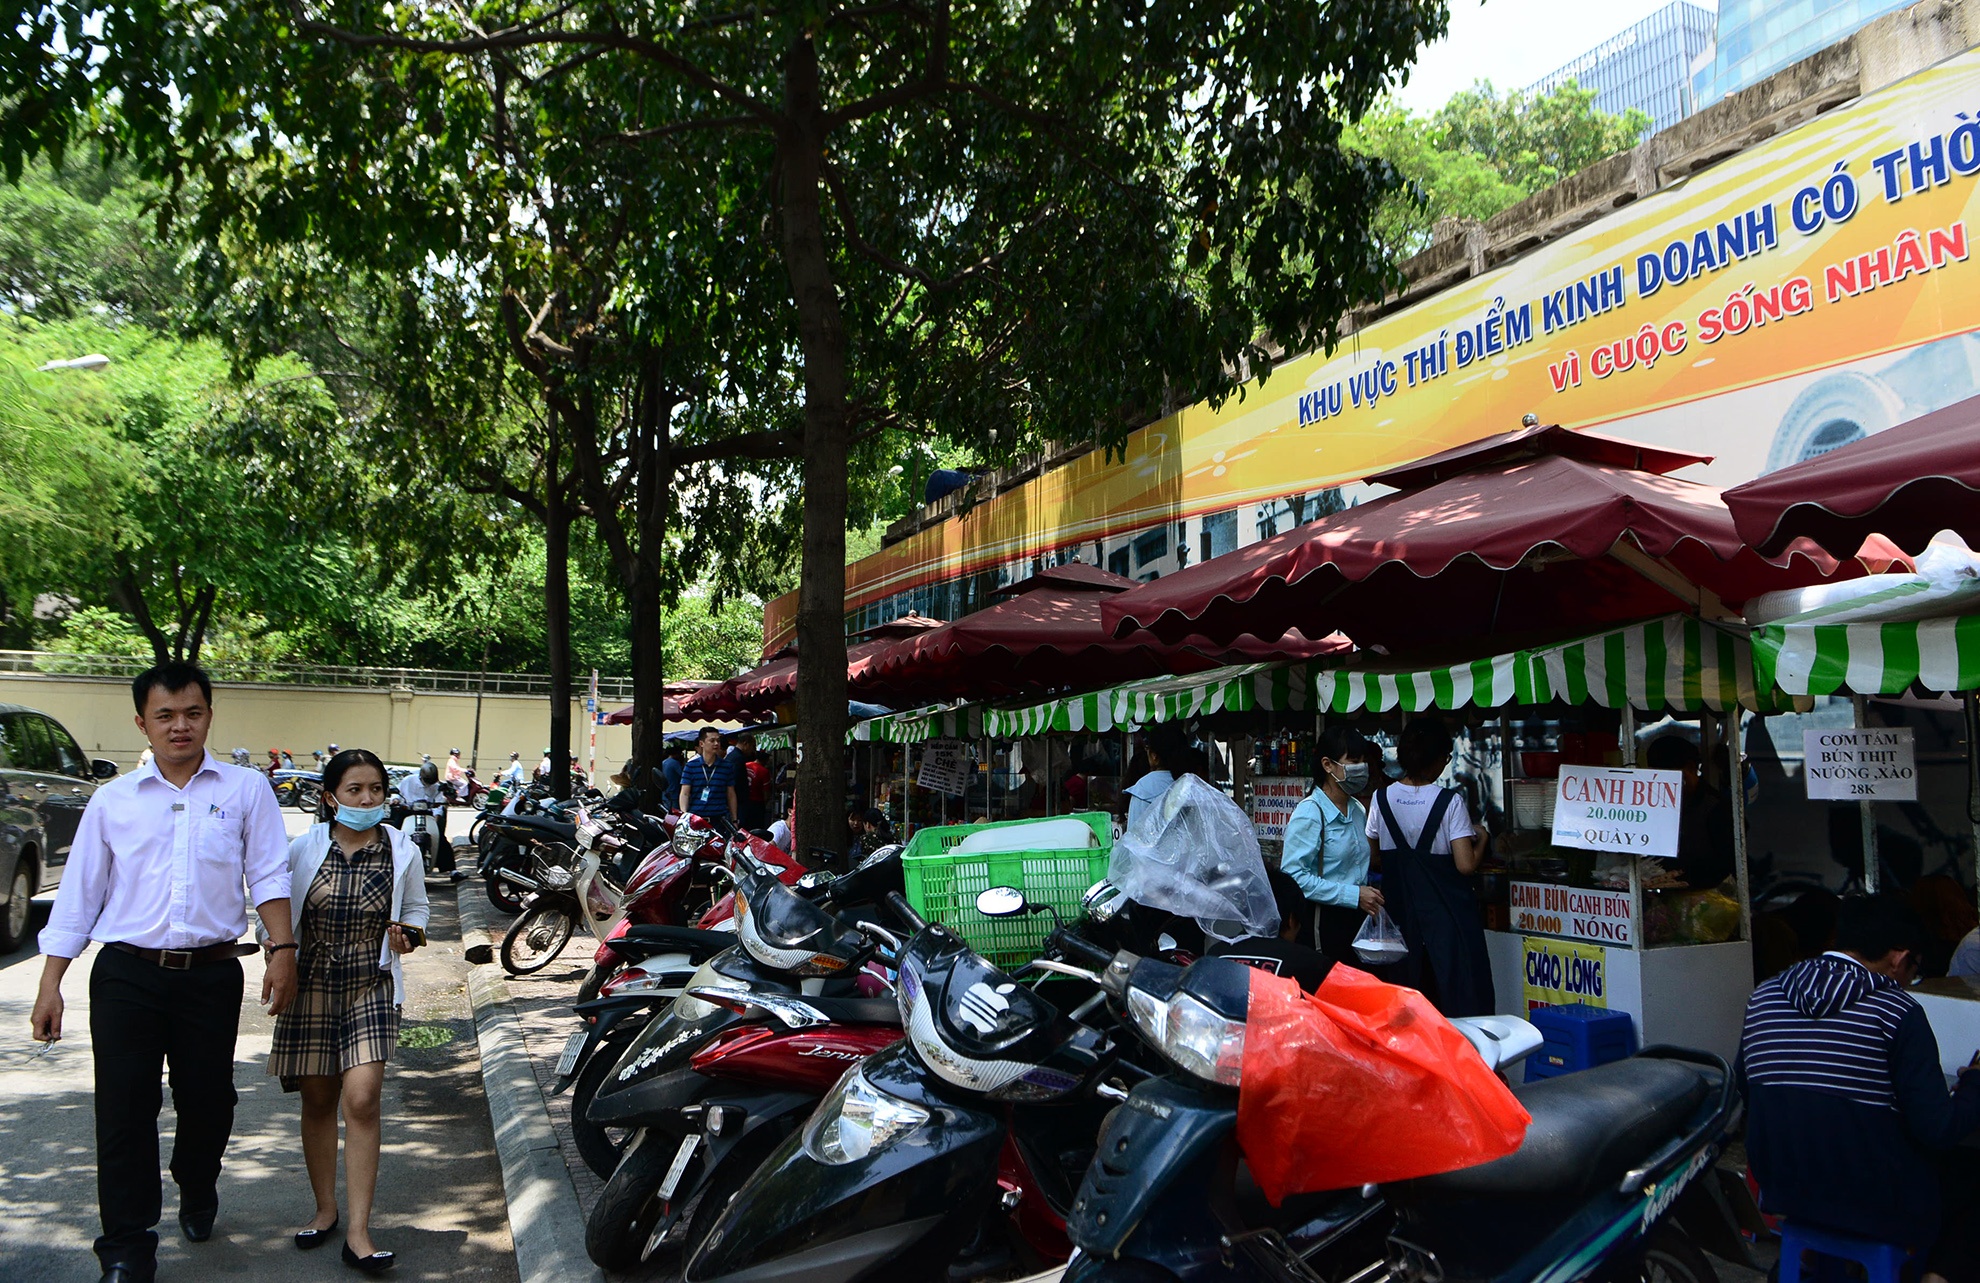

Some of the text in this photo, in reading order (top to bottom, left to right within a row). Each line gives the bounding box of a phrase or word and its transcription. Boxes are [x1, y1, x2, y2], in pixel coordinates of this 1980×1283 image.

[1298, 381, 1342, 425] KHU
[1349, 360, 1397, 407] VỰC
[1403, 329, 1448, 387] THÍ
[1454, 296, 1532, 368] ĐIỂM
[1542, 265, 1624, 333] KINH
[1636, 203, 1776, 298] DOANH
[1791, 159, 1858, 234] CÓ
[1549, 221, 1969, 392] VÌ CUỘC SỐNG NHÂN
[1819, 734, 1858, 746] CƠM
[1821, 748, 1897, 765] BÚN THỊT
[1561, 773, 1678, 808] CANH BÚN
[1850, 784, 1876, 795] 28K
[1254, 809, 1270, 824] BÁNH
[1586, 806, 1648, 823] 20.000Đ
[1640, 834, 1650, 847] 9
[1511, 884, 1569, 912] CANH BÚN
[1569, 893, 1631, 919] CANH BÚN
[1519, 912, 1562, 934] 20.000
[1573, 916, 1628, 942] NÓNG
[1526, 945, 1603, 998] CHÁO LÒNG
